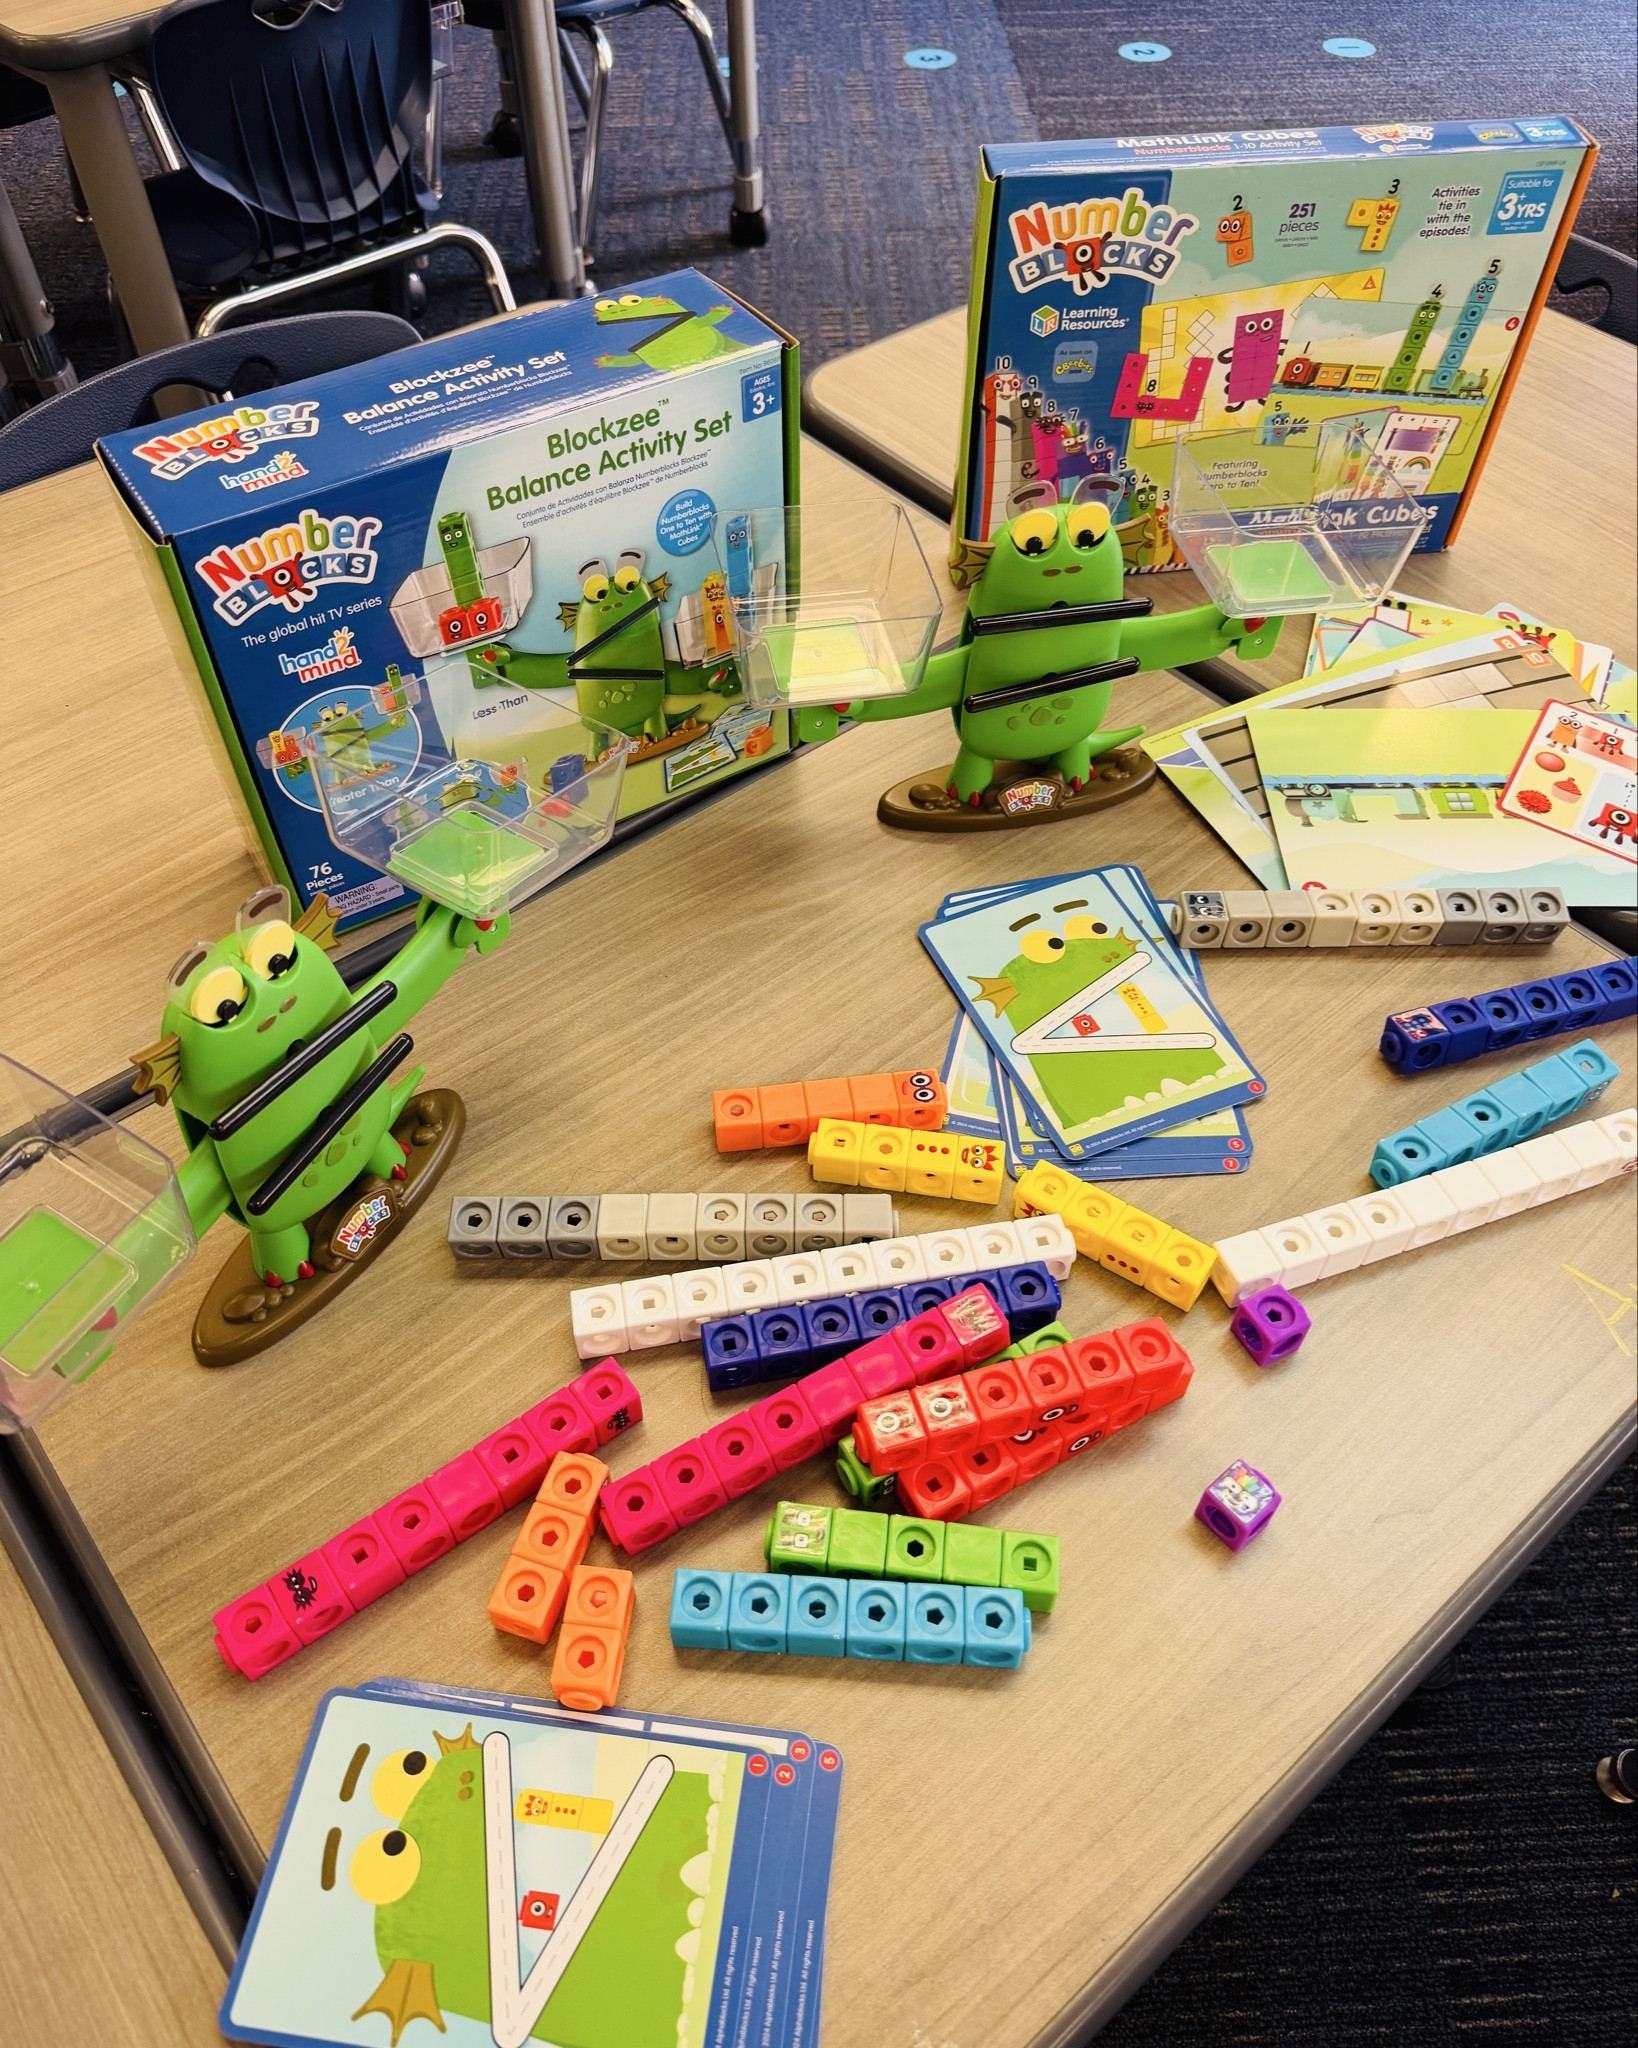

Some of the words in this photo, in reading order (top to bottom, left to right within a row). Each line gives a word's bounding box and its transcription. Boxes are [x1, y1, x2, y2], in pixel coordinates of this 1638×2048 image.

[919, 54, 943, 63] 3
[1131, 47, 1157, 58] 2
[1240, 130, 1318, 142] Cubes
[1133, 144, 1231, 156] Numberblocks
[1233, 142, 1256, 150] 1-10
[1259, 139, 1301, 149] Activity
[1303, 138, 1323, 147] Set
[1388, 178, 1400, 195] 3
[1507, 179, 1540, 189] Suitable
[1541, 177, 1555, 188] for
[1432, 186, 1480, 199] Activities
[1232, 194, 1243, 212] 2
[1438, 200, 1453, 211] tie
[1456, 200, 1466, 210] in
[1288, 203, 1316, 218] 251
[1516, 202, 1547, 219] YRS
[1014, 193, 1194, 254] Number
[1426, 213, 1450, 225] with
[1453, 212, 1471, 223] the
[1279, 220, 1319, 235] pieces
[1419, 225, 1471, 238] episodes!
[1488, 259, 1501, 276] 5
[1432, 284, 1443, 298] 4
[1062, 306, 1118, 319] Learning
[1507, 319, 1518, 330] 4
[1303, 341, 1311, 354] 1
[995, 356, 1011, 370] 10
[754, 374, 771, 386] AGES
[1028, 376, 1037, 389] 9
[1147, 379, 1157, 393] 8
[343, 391, 440, 425] Balance
[444, 364, 525, 396] Activity
[528, 351, 568, 370] Set
[359, 417, 392, 432] Conjunto
[392, 415, 404, 423] de
[404, 403, 445, 419] Actividades
[445, 399, 459, 407] con
[458, 390, 488, 404] Balanza
[487, 375, 538, 394] Numberblocks
[368, 422, 404, 436] Ensemble
[523, 371, 573, 390] Numberblocks
[752, 392, 775, 415] 3+
[1047, 401, 1056, 412] 8
[1274, 400, 1283, 411] 5
[1070, 408, 1079, 420] 7
[139, 402, 317, 461] Number
[1096, 438, 1104, 449] 6
[486, 463, 592, 511] Balance
[598, 428, 687, 475] Activity
[694, 411, 733, 442] Set
[1119, 459, 1127, 470] 5
[1212, 460, 1258, 470] Featuring
[244, 465, 306, 491] mind
[1142, 473, 1151, 484] 4
[1227, 481, 1237, 489] to
[1240, 479, 1260, 488] Ten!
[516, 505, 547, 520] Conjunto
[547, 502, 557, 510] de
[557, 489, 595, 507] Actividades
[595, 485, 608, 493] con
[608, 476, 635, 490] Balanza
[635, 461, 680, 481] Numberblocks
[522, 512, 556, 529] Ensemble
[655, 475, 664, 484] de
[664, 461, 709, 480] Numberblocks
[1162, 490, 1170, 501] 3
[675, 499, 693, 511] Build
[661, 503, 710, 525] Numberblocks
[1367, 503, 1438, 524] Cubes
[660, 525, 675, 535] One
[676, 521, 684, 530] to
[685, 517, 697, 528] Ten
[697, 511, 713, 524] with
[677, 535, 699, 547] Cubes
[200, 515, 377, 592] Number
[241, 633, 266, 649] The
[271, 617, 309, 643] global
[310, 612, 326, 627] hit
[326, 607, 343, 622] TV
[346, 596, 382, 615] series
[1526, 651, 1545, 665] 10
[472, 705, 498, 720] Less
[500, 693, 529, 710] Than
[1569, 711, 1578, 720] 2
[1007, 783, 1054, 801] Number
[308, 862, 332, 879] 76
[306, 872, 344, 891] Pieces
[335, 883, 378, 903] WARNING:
[348, 894, 371, 906] HAZARD
[376, 888, 389, 898] Small
[355, 902, 368, 912] under
[1233, 1140, 1240, 1149] 5
[1227, 1159, 1235, 1168] 7
[339, 1197, 385, 1244] Number
[795, 1747, 806, 1755] 3
[824, 1756, 835, 1765] 5
[778, 1769, 790, 1780] 2
[773, 1940, 782, 1960] rights
[726, 1956, 735, 1976] rights
[803, 1949, 812, 1969] rights
[724, 1976, 732, 1986] All
[749, 1967, 757, 1987] rights
[801, 1969, 809, 1980] All
[746, 1987, 754, 1997] All
[764, 1984, 776, 2027] Alphablocks
[715, 2000, 728, 2044] Alphablocks
[794, 1993, 806, 2038] Alphablocks
[761, 2027, 770, 2047] 2024
